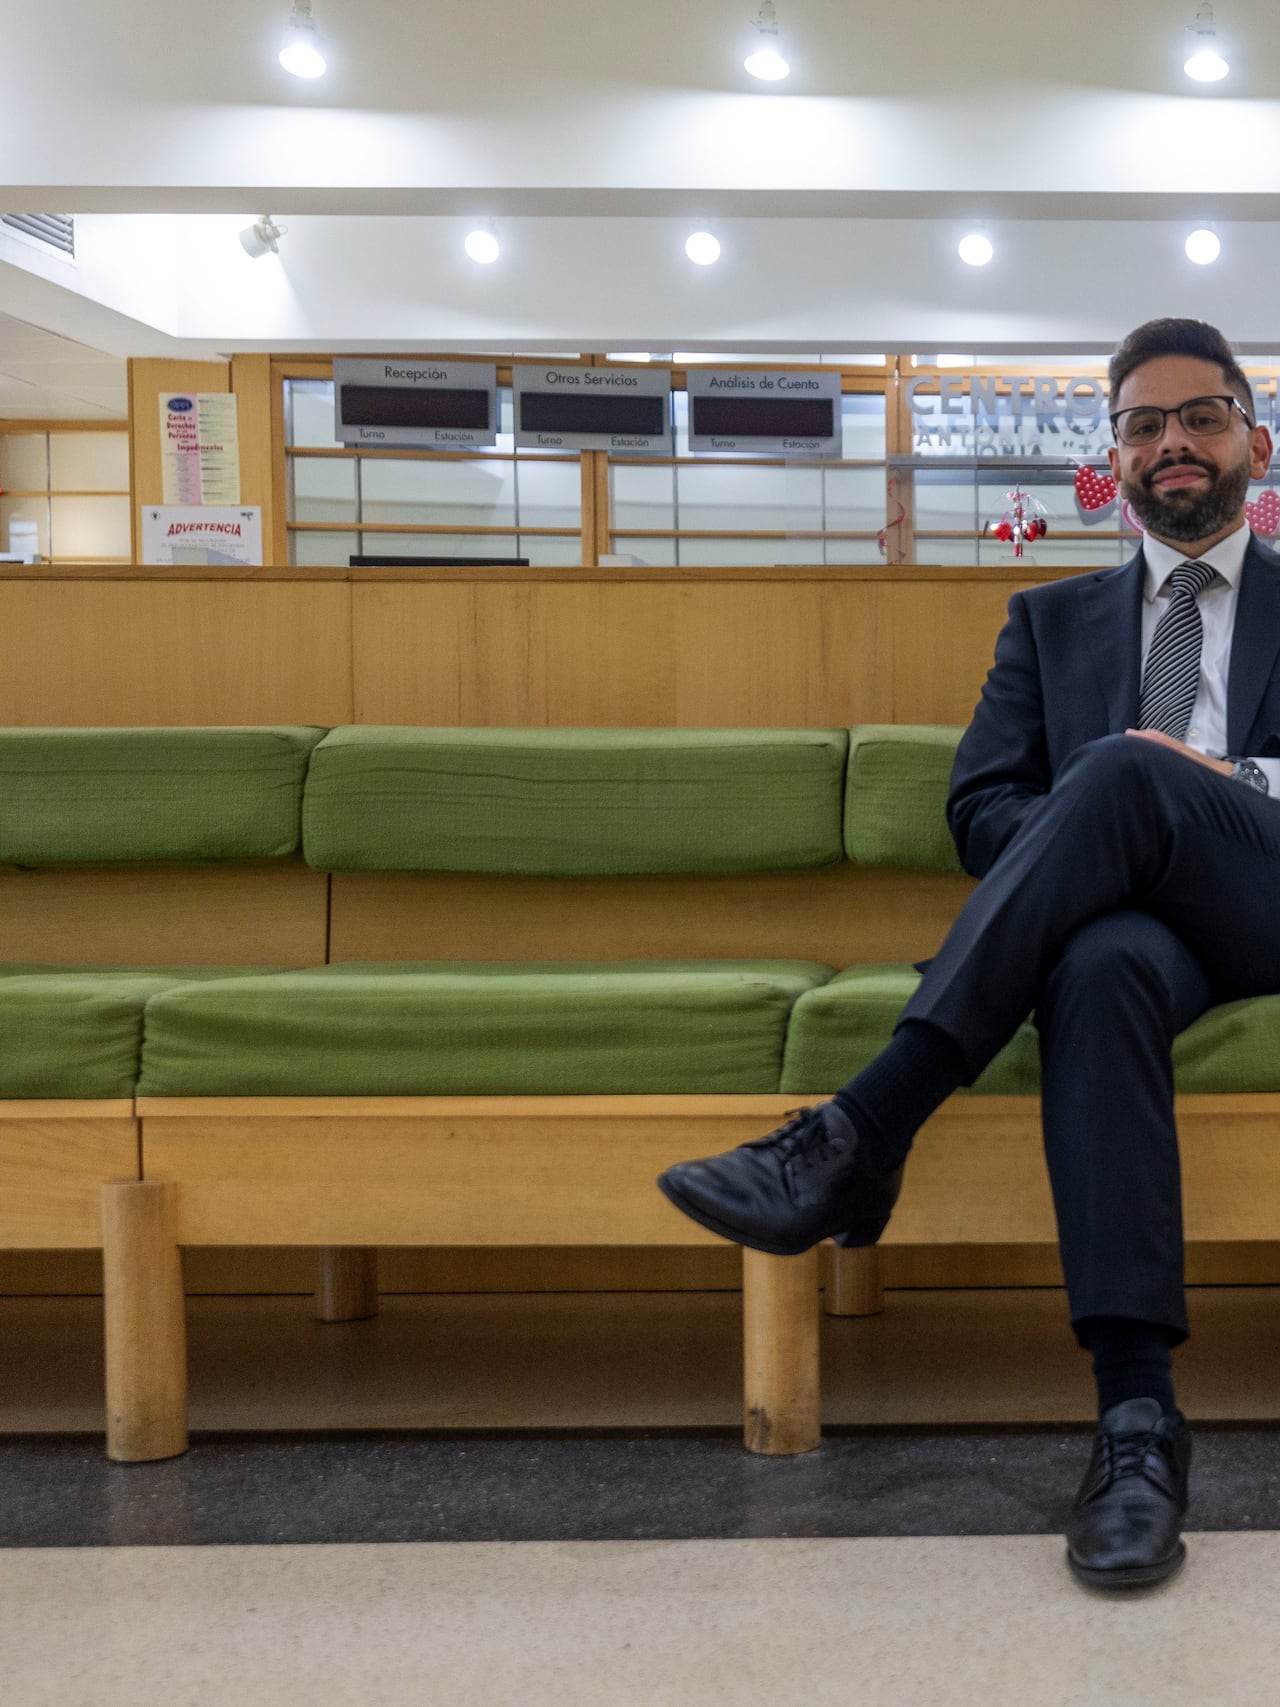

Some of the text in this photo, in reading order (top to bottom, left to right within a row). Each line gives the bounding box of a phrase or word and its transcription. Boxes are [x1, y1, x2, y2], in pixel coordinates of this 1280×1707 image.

[384, 366, 448, 382] Recepción
[546, 371, 638, 387] Otros Servicios
[709, 374, 820, 391] Análisis de Cuenta
[905, 376, 1104, 415] CENTRO
[359, 428, 474, 442] Turno Estación
[537, 434, 649, 447] Turno Estación
[914, 426, 1045, 447] ANTONIA
[711, 438, 820, 449] Turno Estación
[167, 522, 241, 537] ADVERTENCIA
